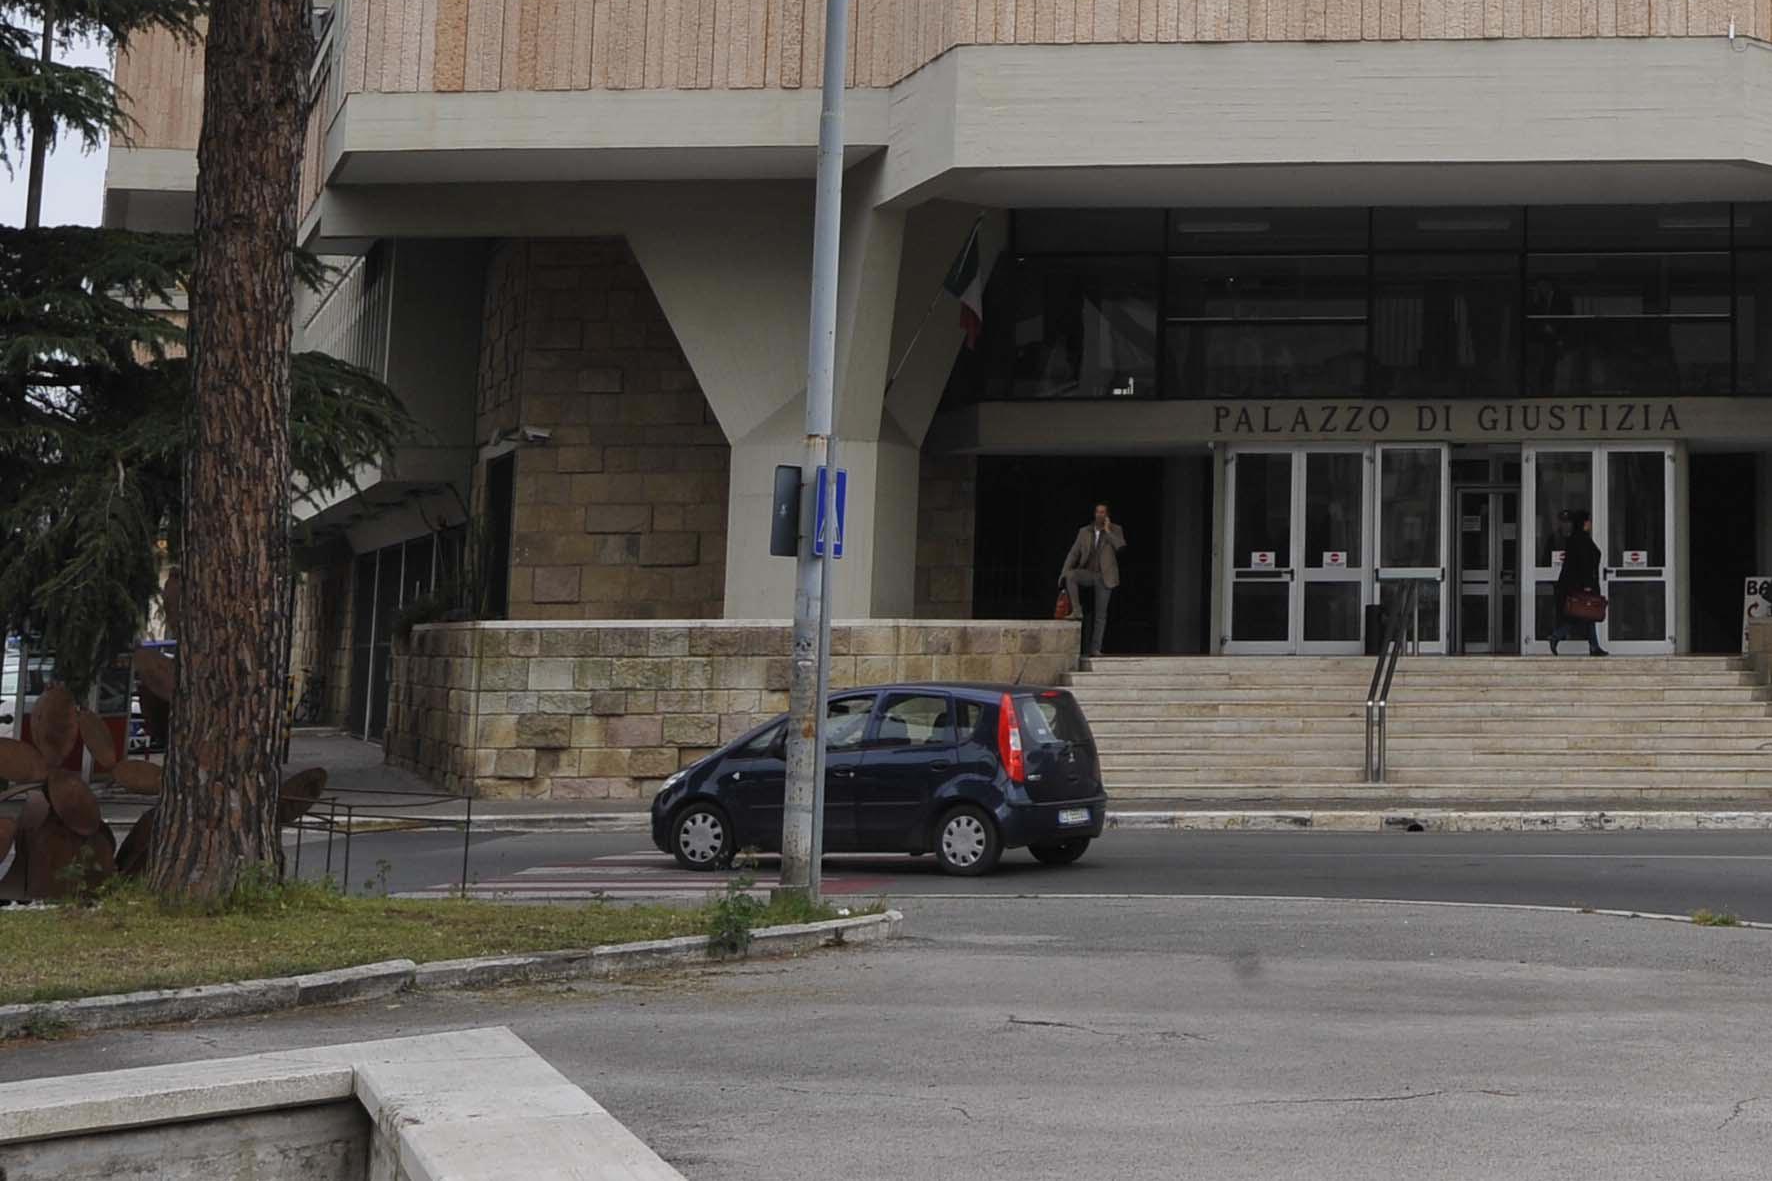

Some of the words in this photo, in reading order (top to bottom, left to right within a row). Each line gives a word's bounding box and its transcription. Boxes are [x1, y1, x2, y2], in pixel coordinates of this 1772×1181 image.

[1213, 405, 1391, 433] PALAZZO
[1416, 405, 1452, 432] DI
[1477, 404, 1682, 432] GIUSTIZIA
